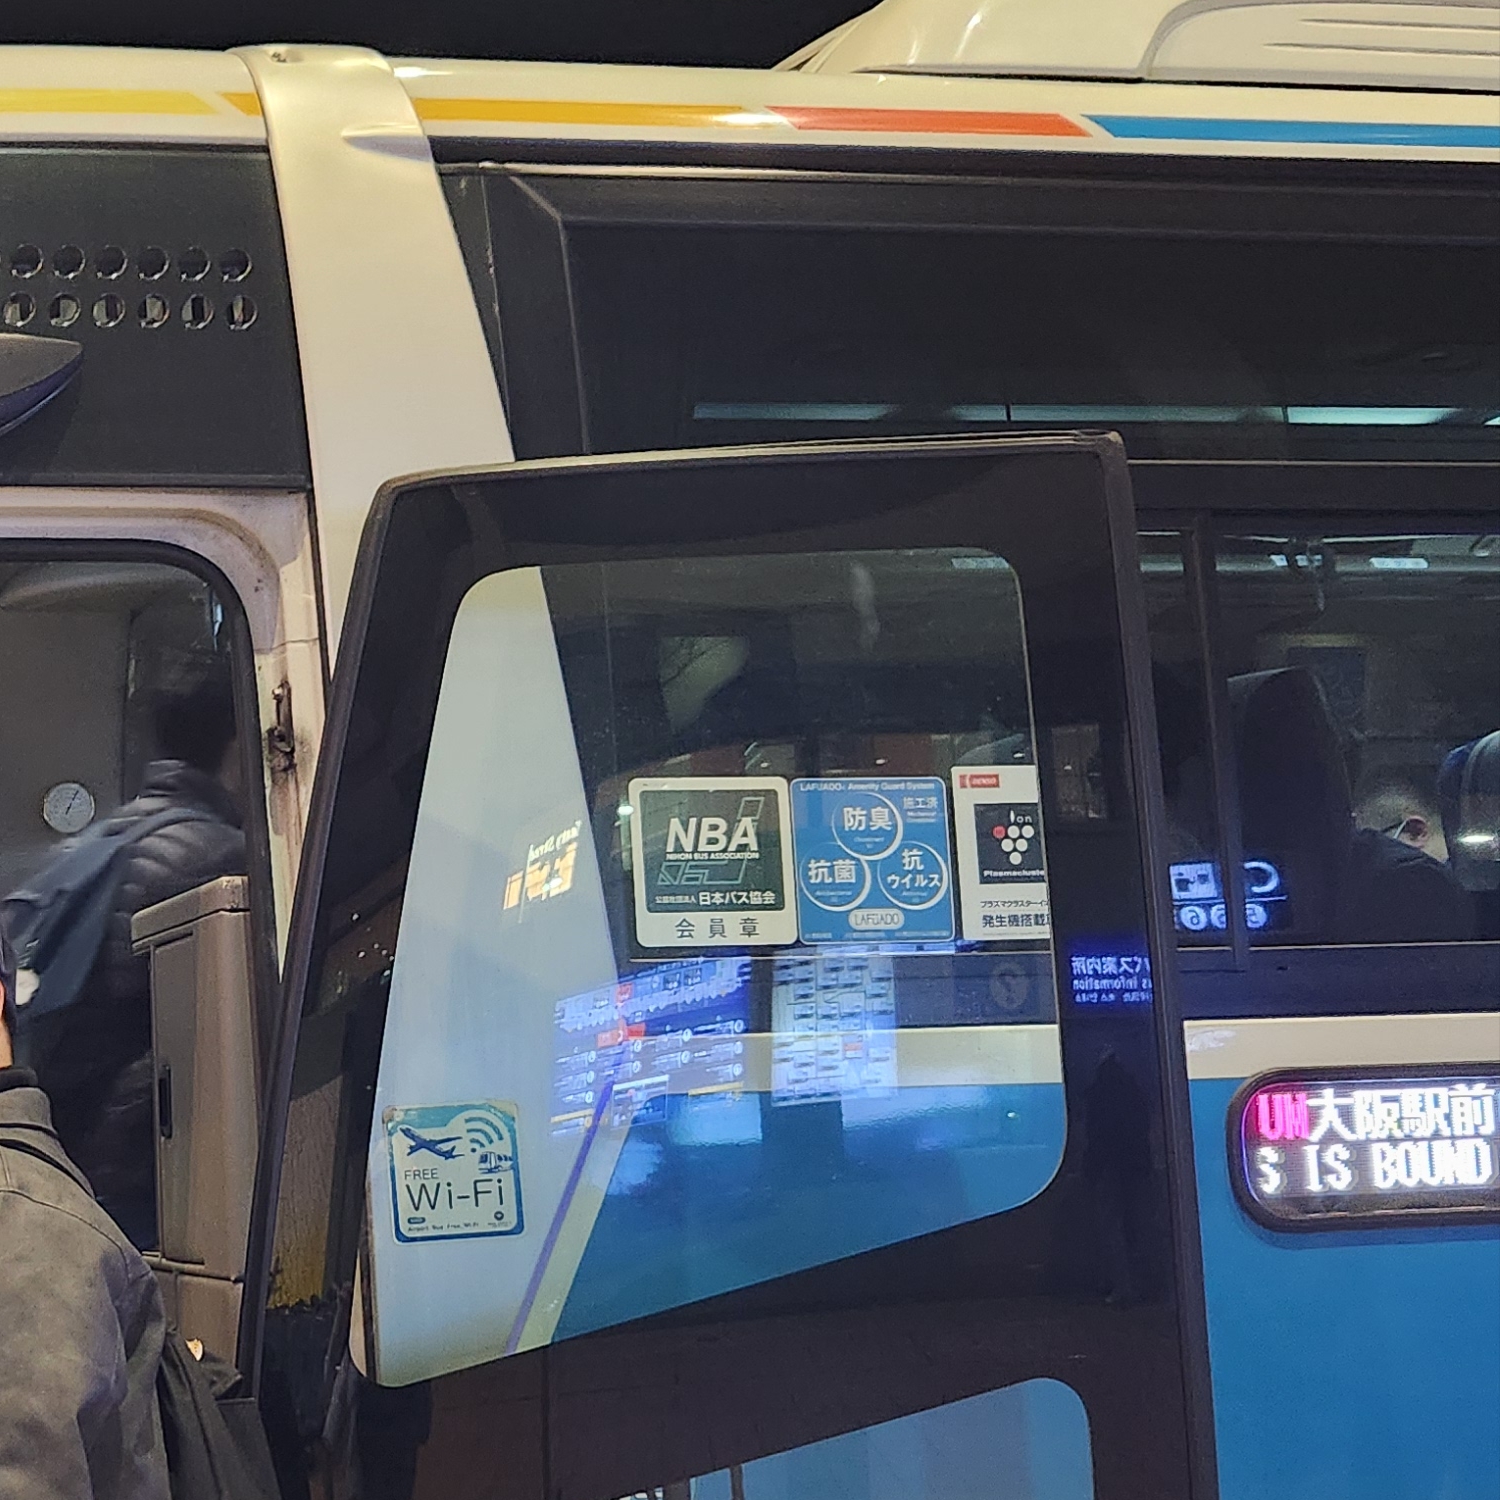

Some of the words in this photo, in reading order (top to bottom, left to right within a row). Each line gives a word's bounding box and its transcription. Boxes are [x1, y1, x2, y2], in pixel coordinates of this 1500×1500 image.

[906, 782, 934, 790] System
[843, 806, 892, 831] 防臭
[666, 817, 759, 852] NBA
[694, 852, 708, 860] BUS
[902, 849, 924, 871] 抗
[808, 859, 857, 884] 抗菌
[887, 874, 941, 888] ウイルス
[699, 891, 775, 905] 日本バス協会
[675, 917, 760, 938] 会員章
[404, 1168, 439, 1180] FREE
[1303, 1144, 1352, 1192] IS
[1371, 1138, 1494, 1189] BOUND
[405, 1178, 504, 1212] Wi-Fi
